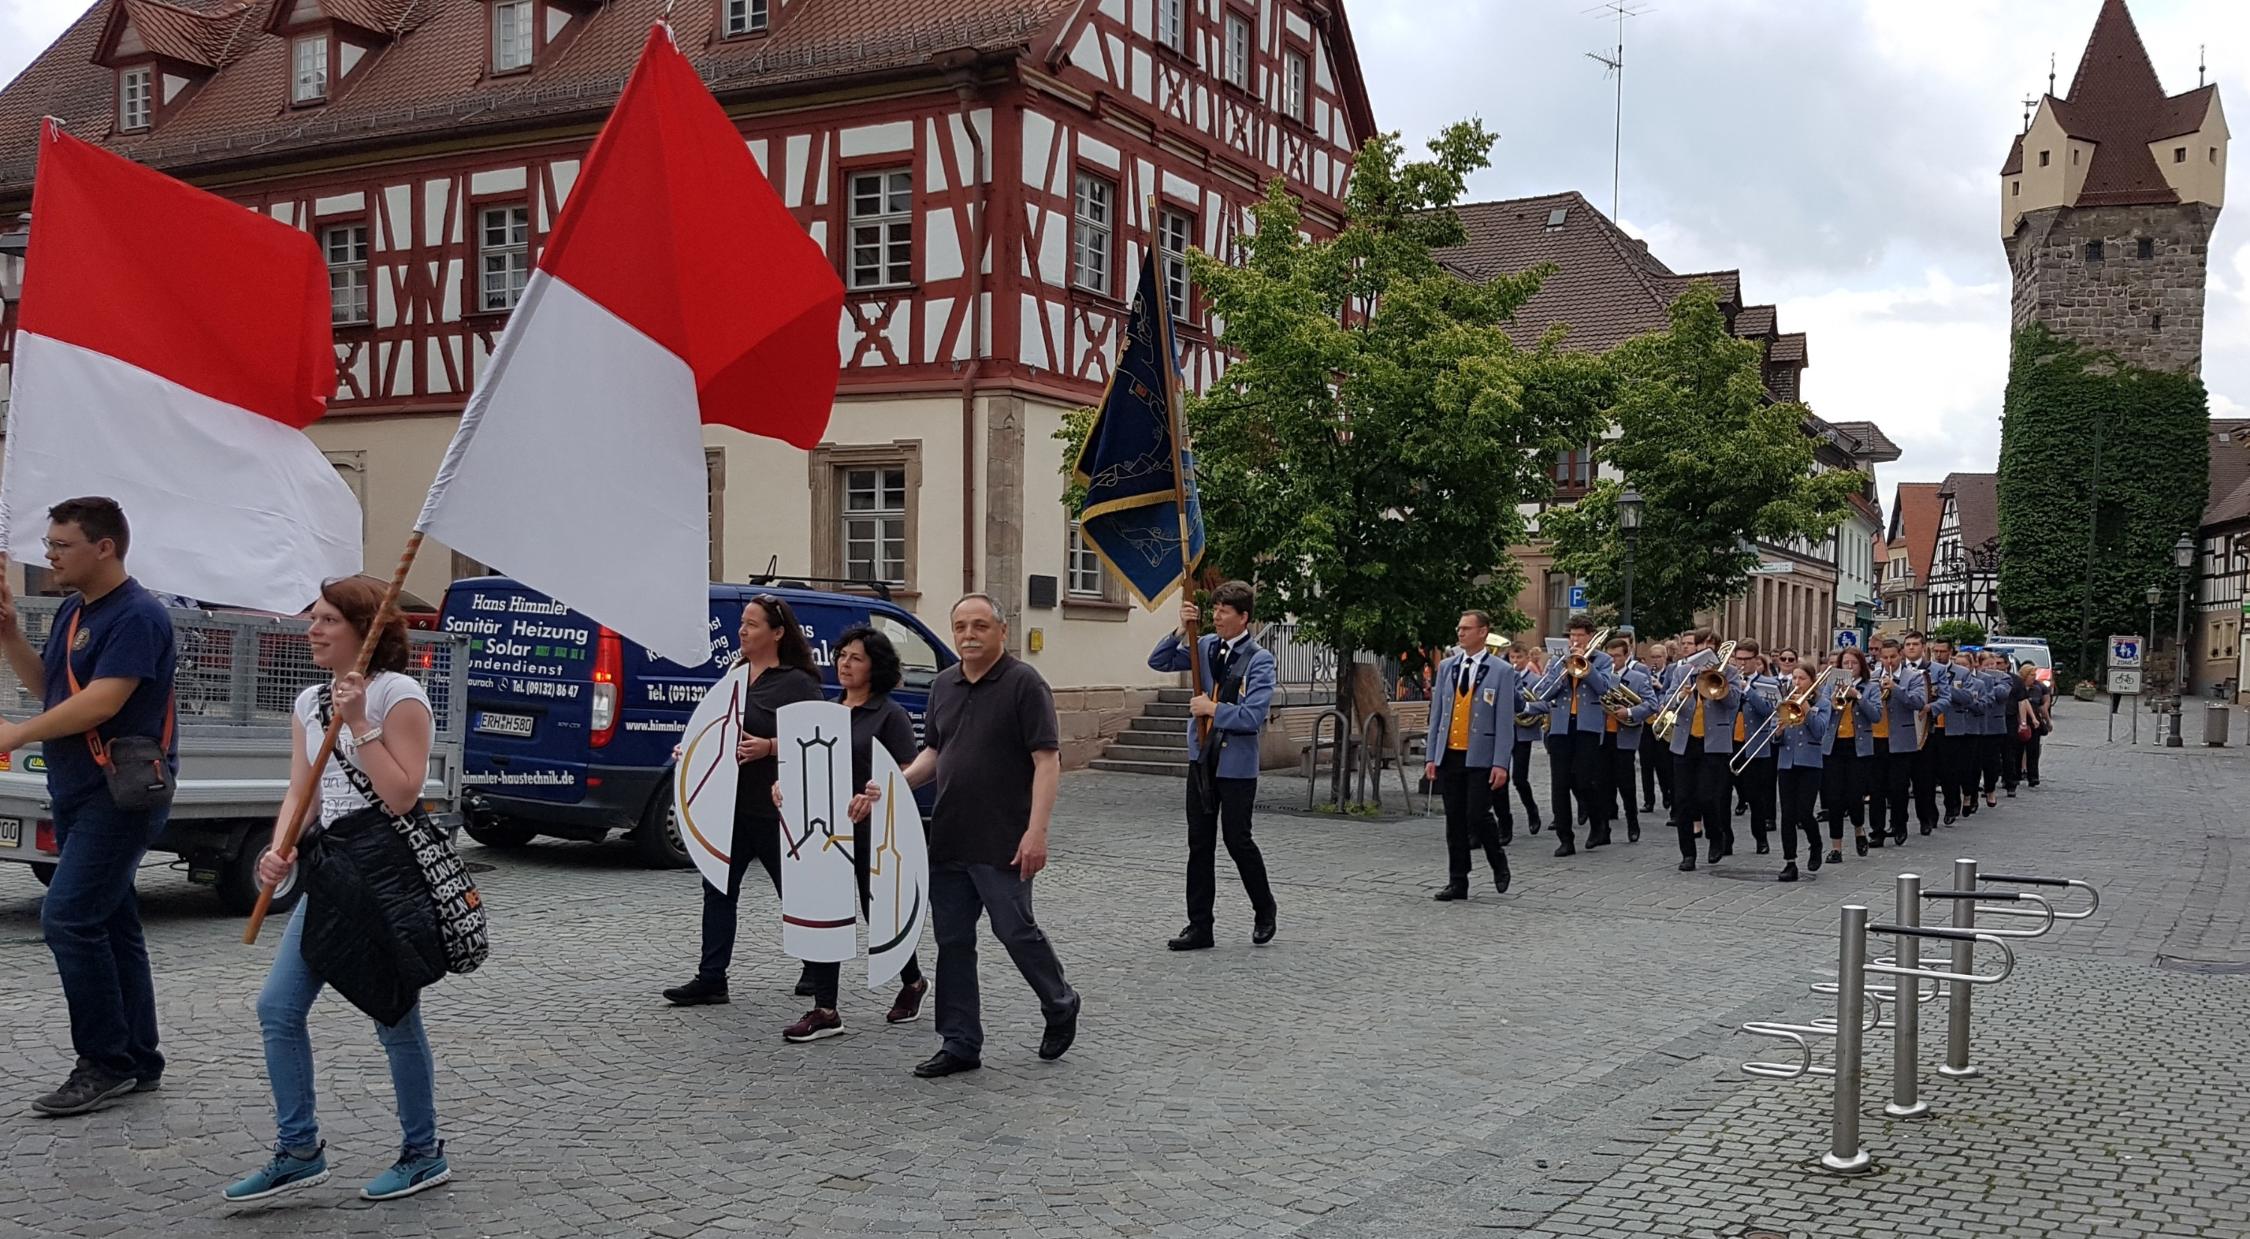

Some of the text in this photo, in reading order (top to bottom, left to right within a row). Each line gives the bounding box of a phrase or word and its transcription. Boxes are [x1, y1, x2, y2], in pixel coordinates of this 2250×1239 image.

[472, 594, 571, 616] Hans Himmler
[1573, 589, 1583, 605] P
[445, 616, 589, 645] Sanitär Heizung
[486, 638, 532, 656] Solar
[468, 657, 563, 676] undendienst
[512, 680, 525, 693] Tel.
[526, 681, 555, 698] (09132)
[556, 683, 567, 695] 86
[568, 684, 579, 698] 47
[647, 684, 666, 701] Tel.
[481, 714, 501, 729] ERH
[625, 719, 687, 732] www.himmler
[462, 770, 575, 785] himmler-haustechnik.de
[0, 822, 17, 840] 00
